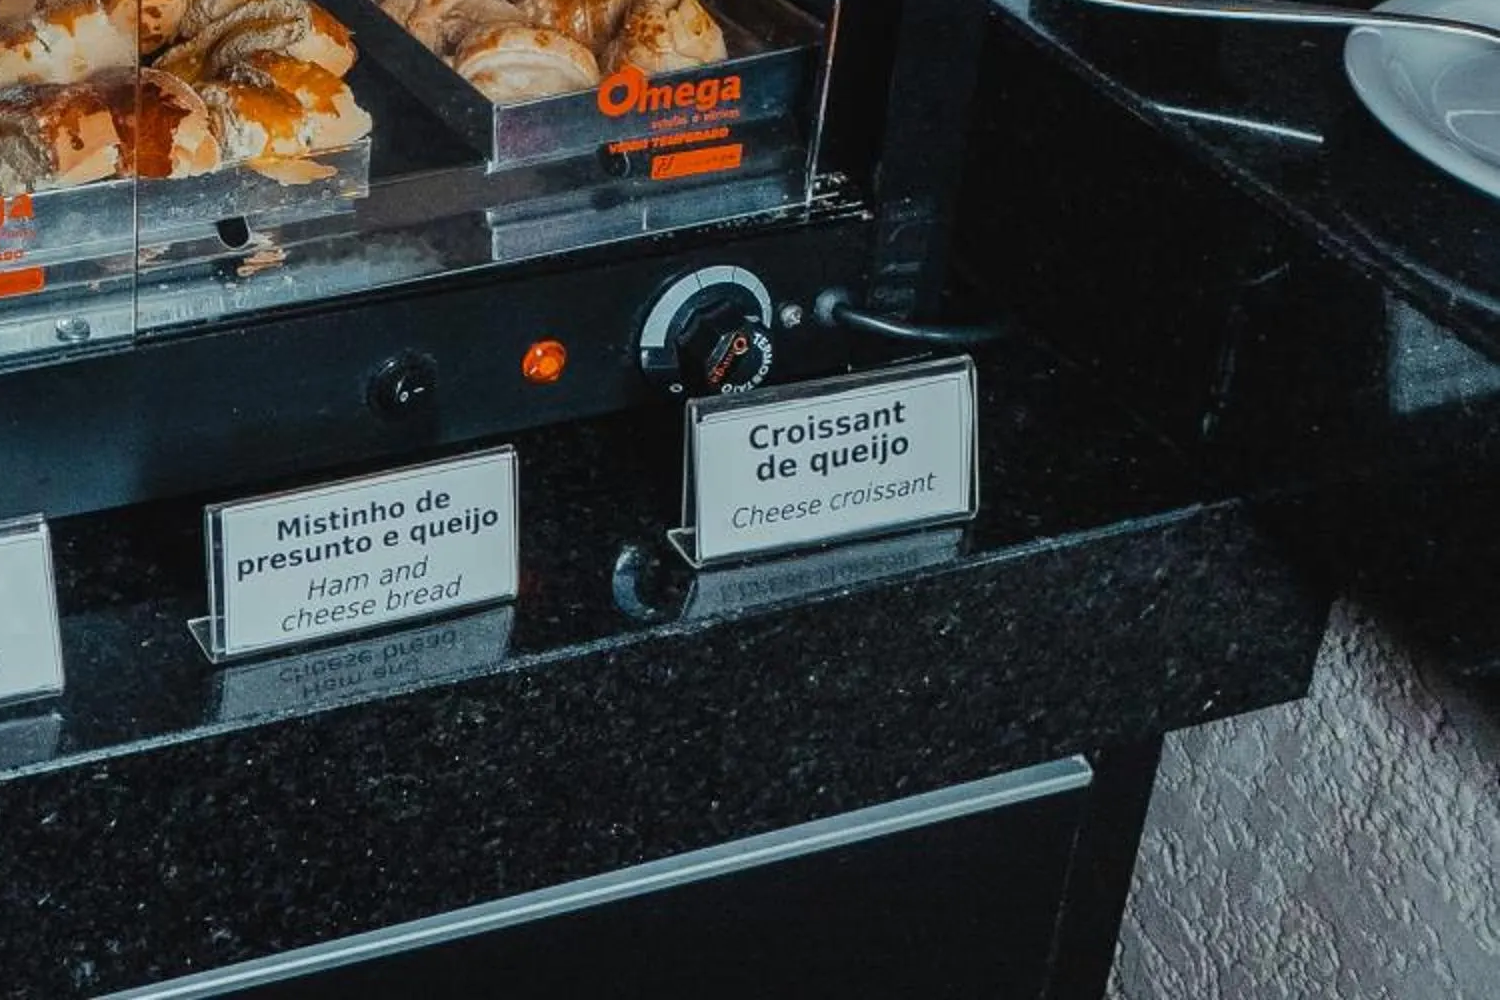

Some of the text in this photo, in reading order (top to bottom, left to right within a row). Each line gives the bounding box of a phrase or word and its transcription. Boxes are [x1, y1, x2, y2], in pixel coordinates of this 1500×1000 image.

[598, 63, 741, 116] Omega
[750, 401, 906, 449] Croissant
[757, 434, 908, 481] de queijo
[277, 490, 450, 540] Mistinho de
[732, 472, 936, 528] Cheese croissant
[238, 508, 498, 581] presunto e queijo
[308, 555, 428, 600] Ham and
[282, 576, 462, 632] cheese bread
